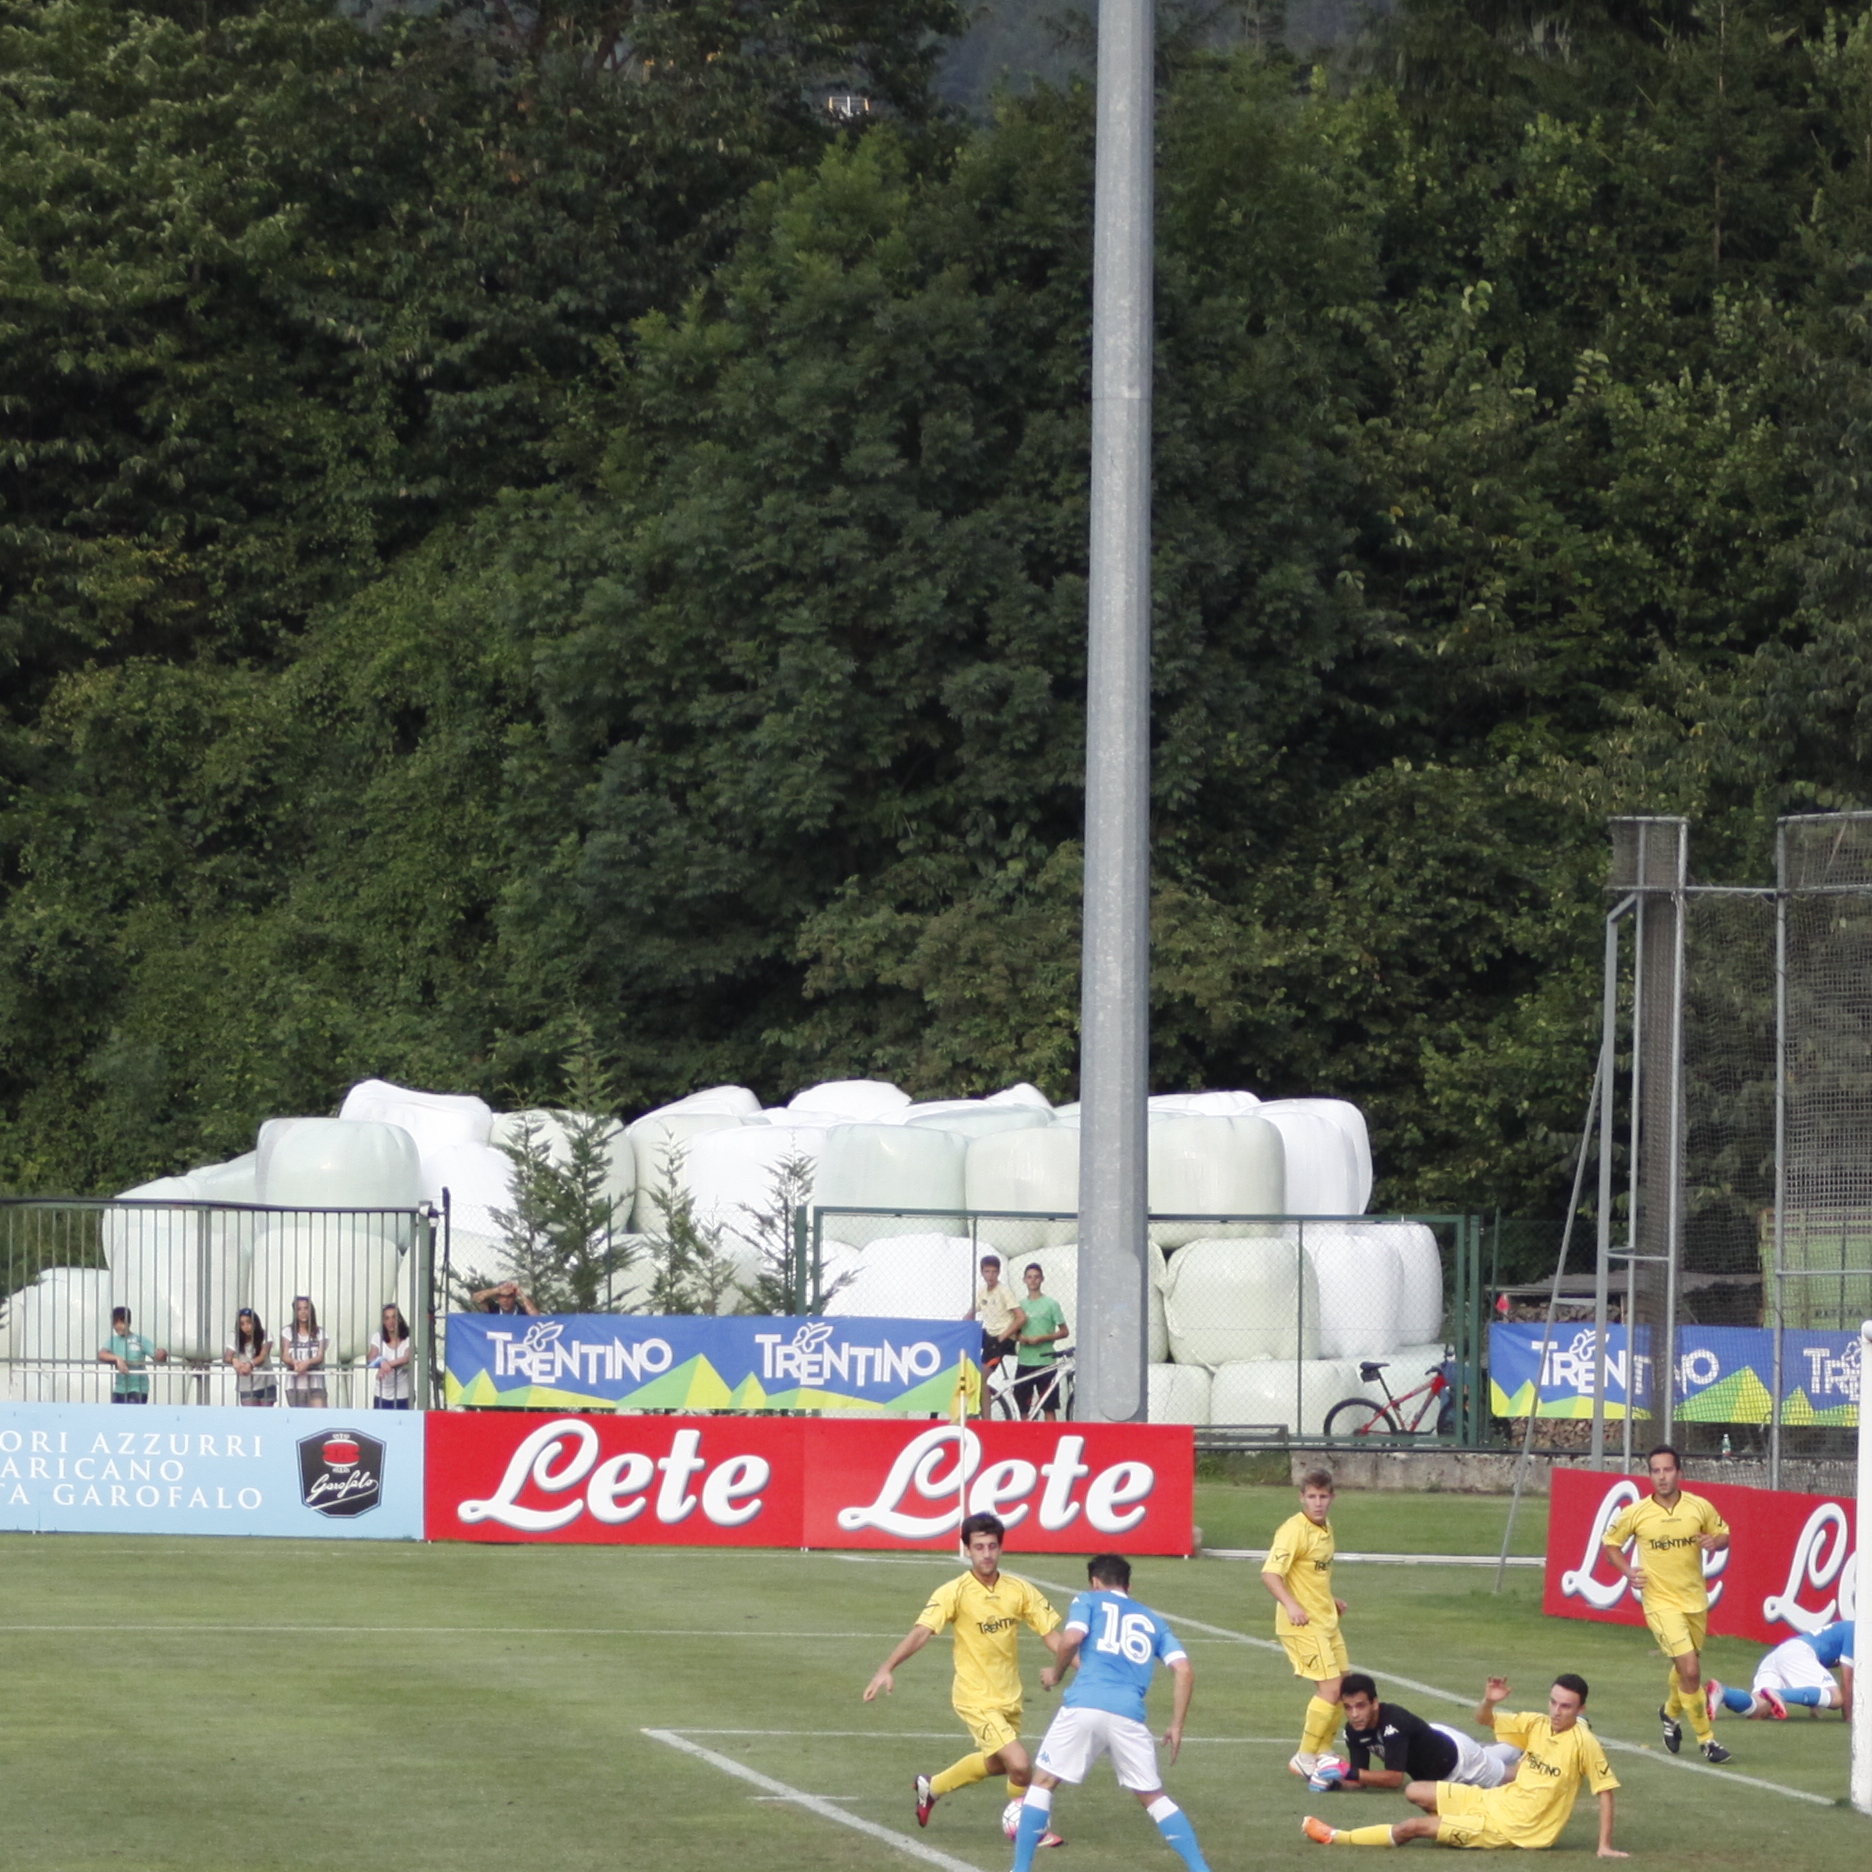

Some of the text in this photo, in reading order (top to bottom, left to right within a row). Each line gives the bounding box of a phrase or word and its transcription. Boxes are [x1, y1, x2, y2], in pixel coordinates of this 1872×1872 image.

[486, 1331, 673, 1384] TRENTINO
[755, 1334, 941, 1386] TRENTINO
[90, 1431, 263, 1458] AZZURRI
[53, 1483, 263, 1510] GAROFALO
[306, 1469, 379, 1509] Garofalo
[457, 1418, 771, 1532] Lete
[837, 1424, 1155, 1540] Lete
[1097, 1601, 1155, 1665] 16
